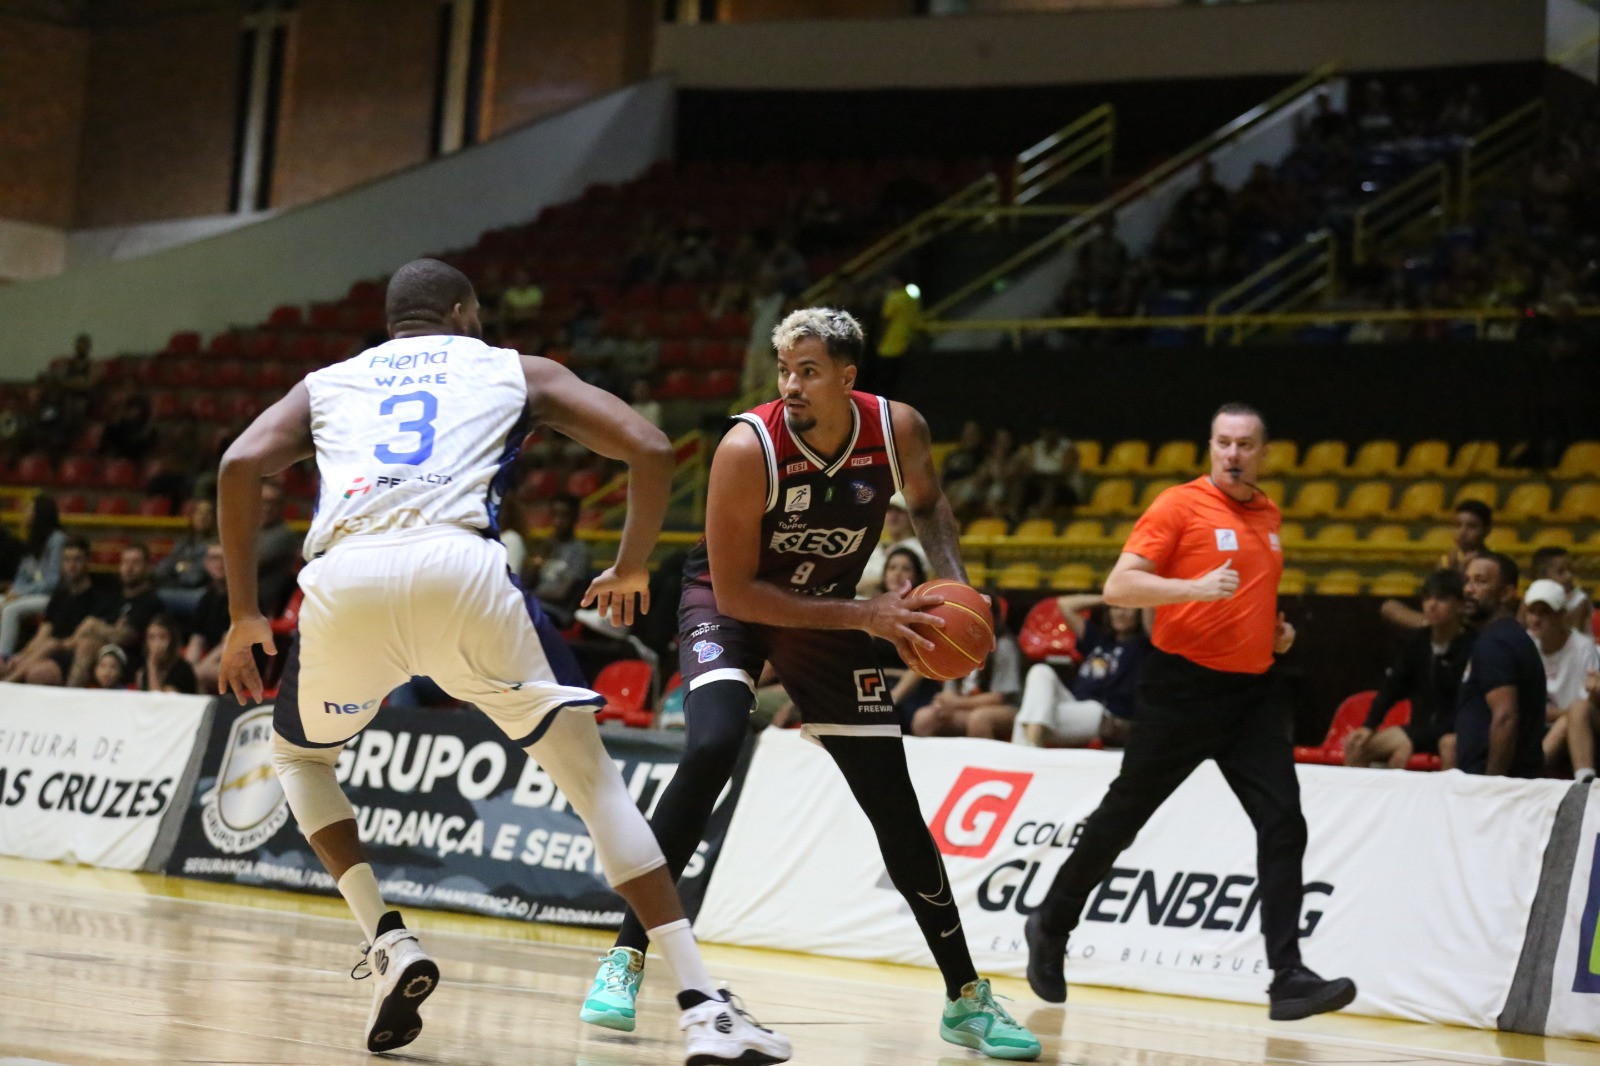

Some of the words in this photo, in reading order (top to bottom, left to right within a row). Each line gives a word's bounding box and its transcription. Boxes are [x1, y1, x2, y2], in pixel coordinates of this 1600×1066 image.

[369, 351, 448, 370] Plena
[375, 372, 448, 388] WARE
[373, 390, 438, 466] 3
[789, 462, 806, 473] SESI
[790, 561, 816, 585] 9
[858, 704, 894, 714] FREEWA
[93, 736, 126, 765] DE
[335, 729, 508, 801] GRUPO
[38, 770, 173, 819] CRUZES
[944, 779, 1013, 848] G
[491, 823, 521, 861] E
[977, 859, 1335, 939] GUENBEG
